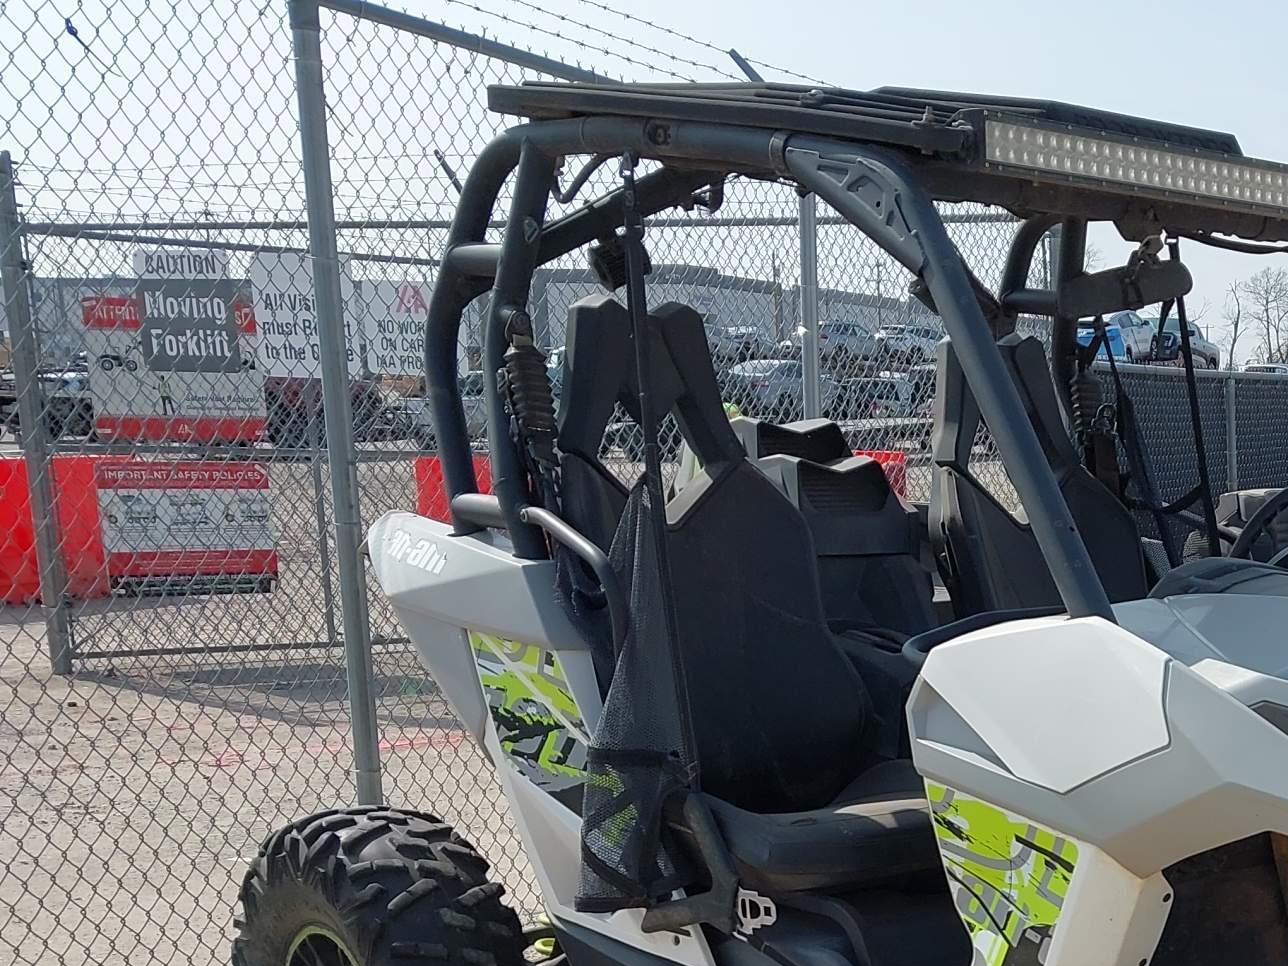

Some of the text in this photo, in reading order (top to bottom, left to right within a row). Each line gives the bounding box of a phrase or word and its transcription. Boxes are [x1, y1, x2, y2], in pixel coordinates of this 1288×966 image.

[145, 254, 216, 274] CAUTION
[144, 291, 226, 325] Moving
[263, 320, 298, 337] must
[378, 320, 425, 335] NO WOR
[150, 328, 230, 357] Forklift
[381, 336, 425, 353] ON CAR
[284, 344, 306, 361] the
